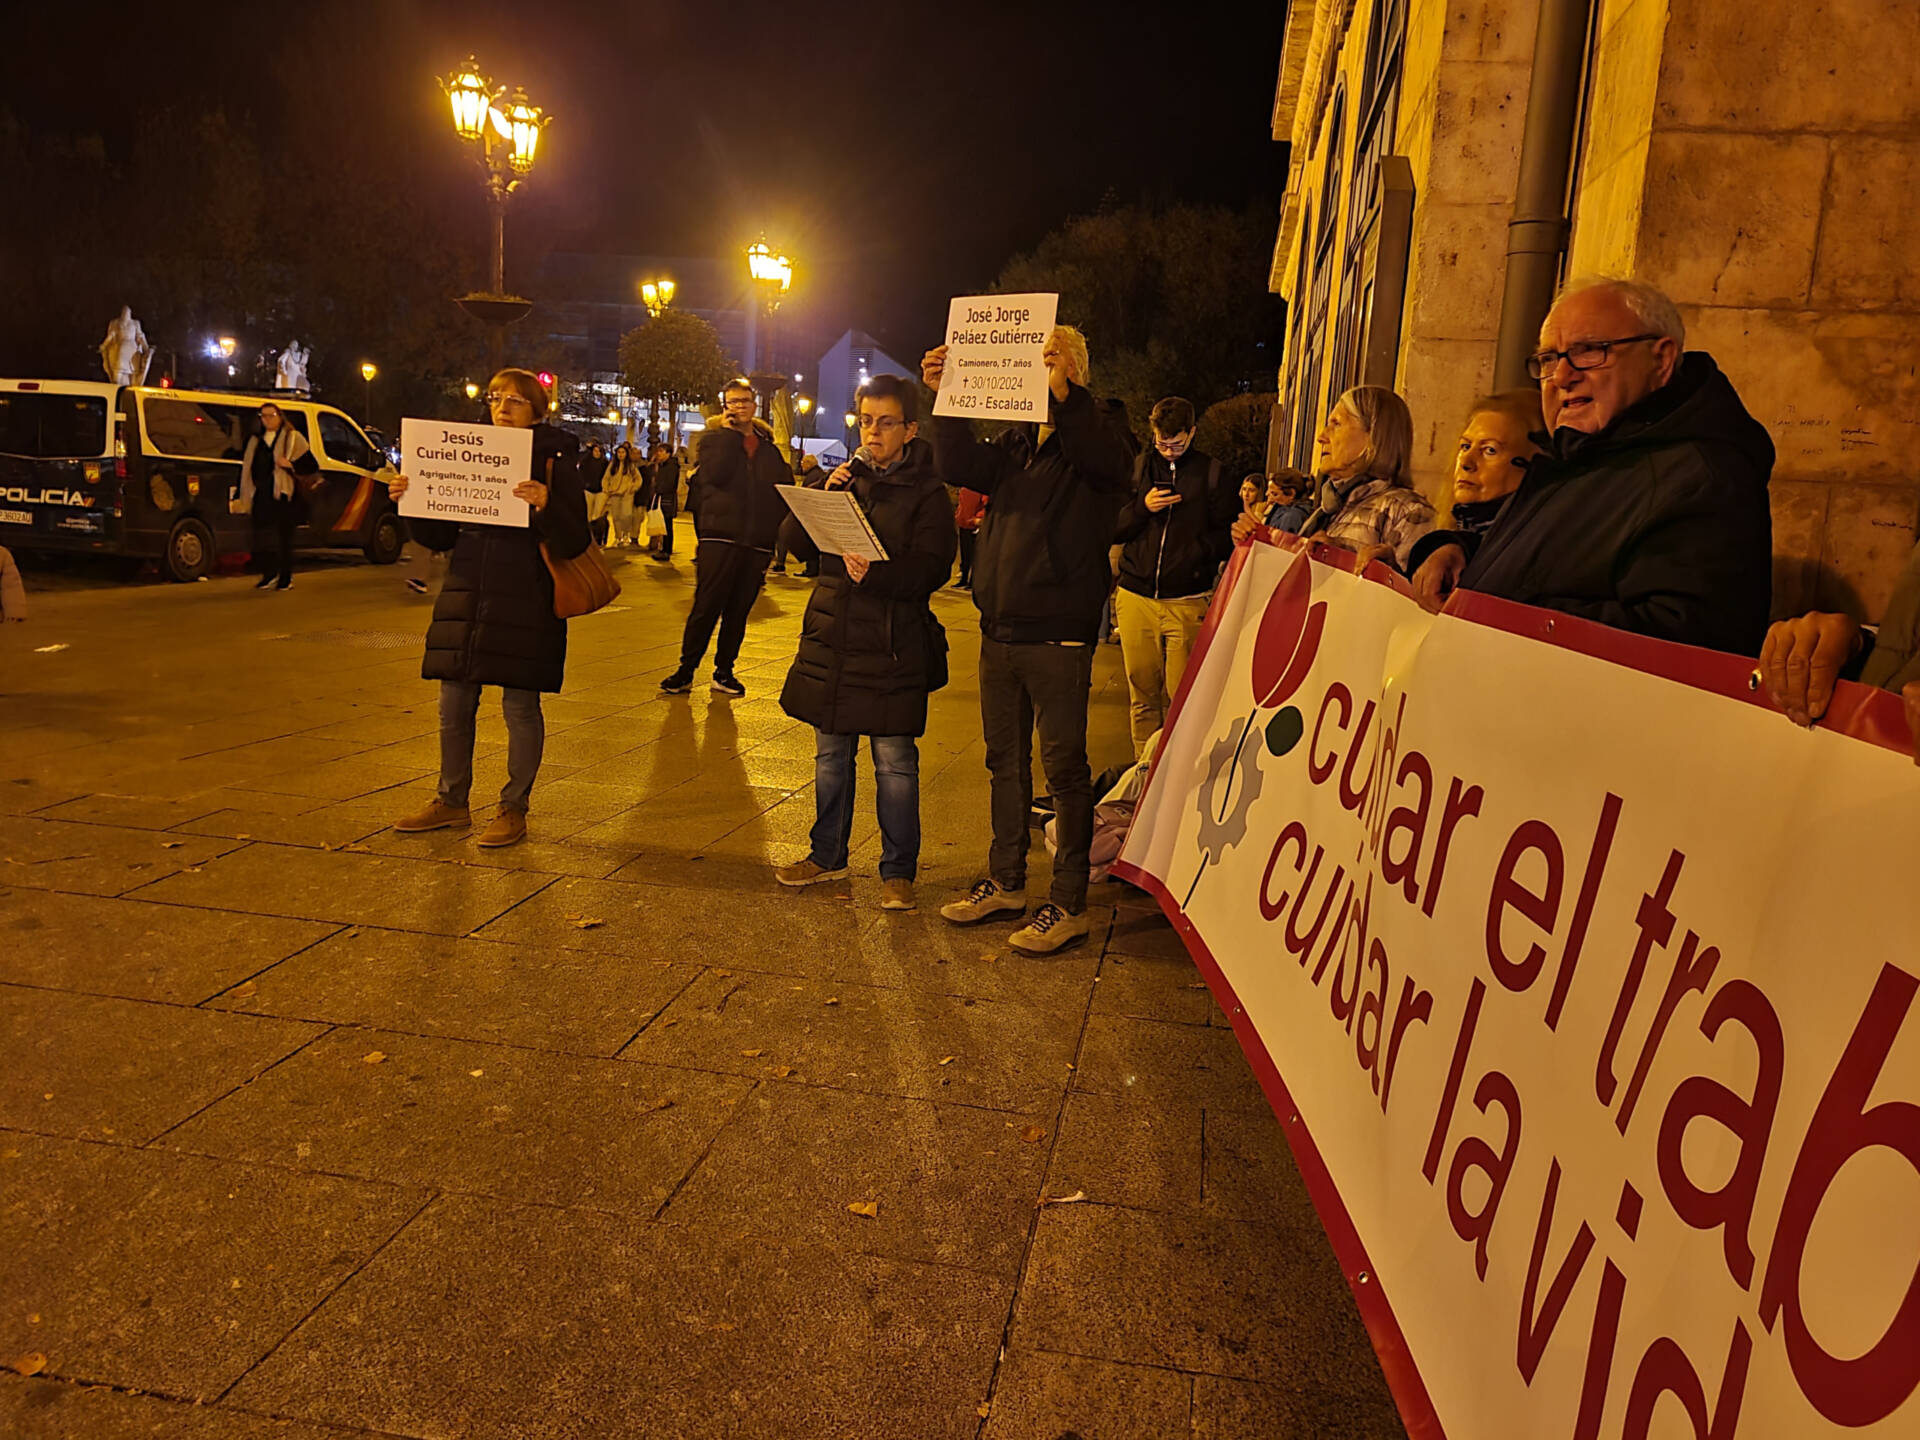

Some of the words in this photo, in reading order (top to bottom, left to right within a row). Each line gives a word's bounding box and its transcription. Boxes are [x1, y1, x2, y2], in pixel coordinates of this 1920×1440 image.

[966, 306, 992, 323] José
[995, 307, 1030, 325] Jorge
[952, 330, 987, 345] Peláez
[990, 329, 1044, 344] Gutiérrez
[958, 358, 1000, 368] Camionero,
[1002, 358, 1011, 367] 57
[1013, 358, 1032, 368] años
[971, 376, 1023, 390] 30/10/2024
[948, 395, 977, 409] N-623
[985, 396, 1033, 411] Escalada
[441, 430, 484, 446] Jesús
[416, 447, 457, 461] Curiel
[461, 450, 510, 467] Ortega
[471, 473, 482, 482] 31
[485, 474, 508, 485] años
[438, 485, 501, 501] 05/11/2024
[426, 500, 500, 517] Hormazuela
[1308, 681, 1485, 919] cuidar
[1486, 791, 1623, 1033] el
[1258, 820, 1434, 1116] cuidar
[1422, 975, 1522, 1283] la
